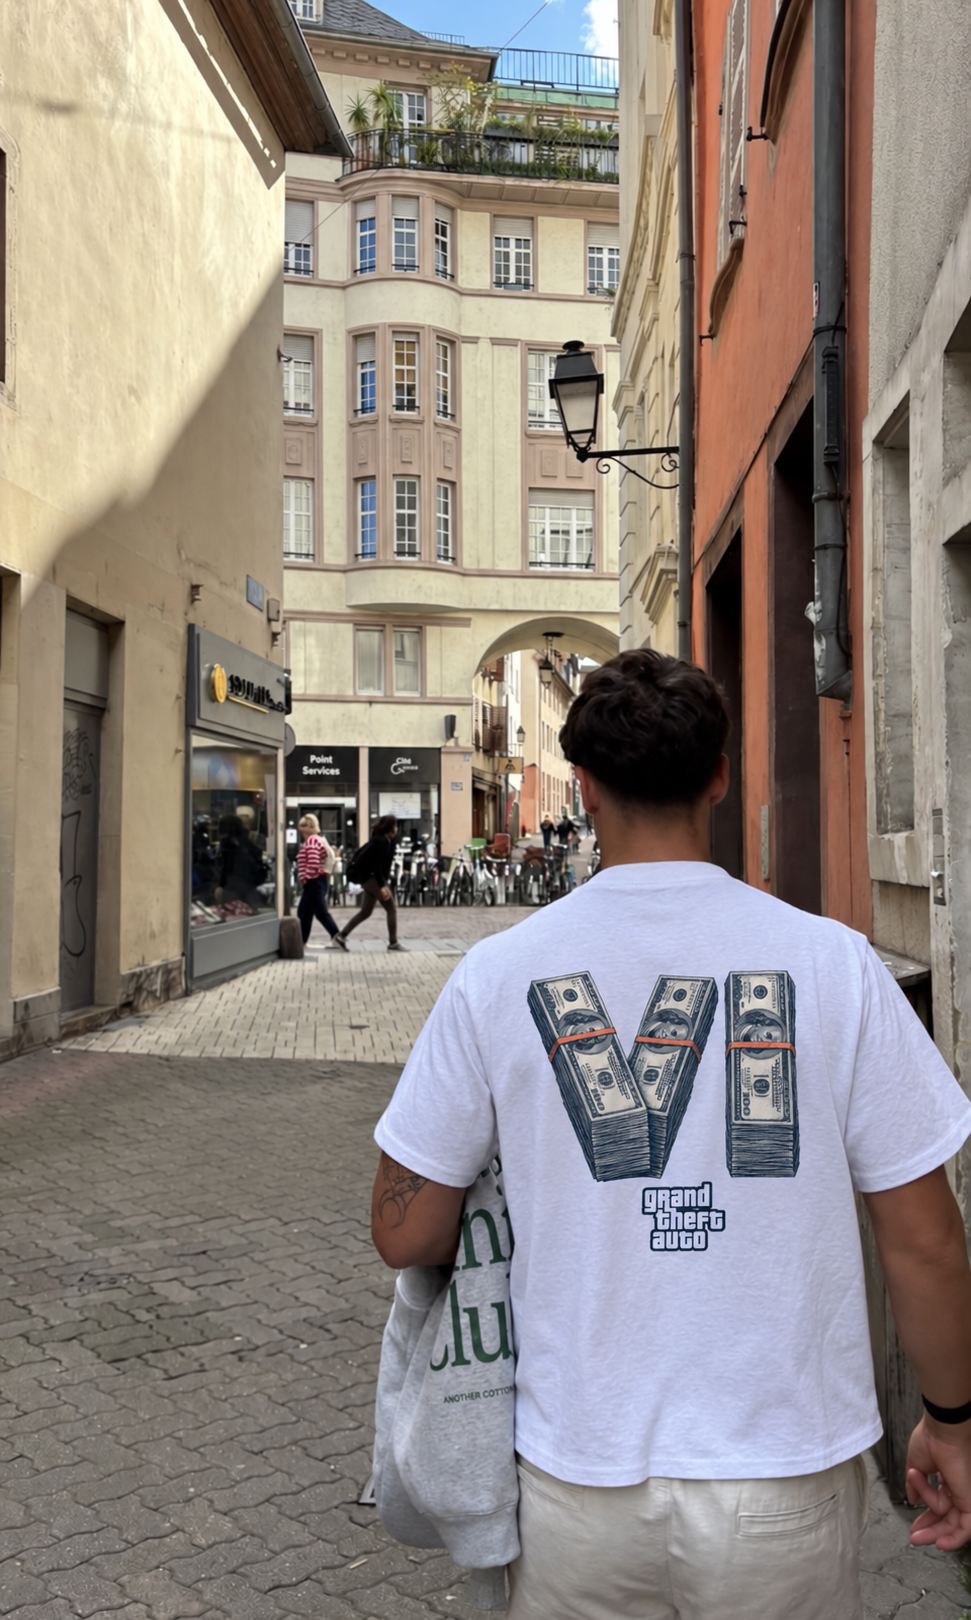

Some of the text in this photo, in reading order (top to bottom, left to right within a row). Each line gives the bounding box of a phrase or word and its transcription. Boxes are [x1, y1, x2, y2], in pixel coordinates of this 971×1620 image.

[309, 754, 333, 764] Point
[302, 765, 340, 776] Services
[642, 1182, 713, 1214] grand
[654, 1207, 726, 1232] theft
[650, 1229, 708, 1252] auto
[443, 1391, 481, 1404] ANOTHER
